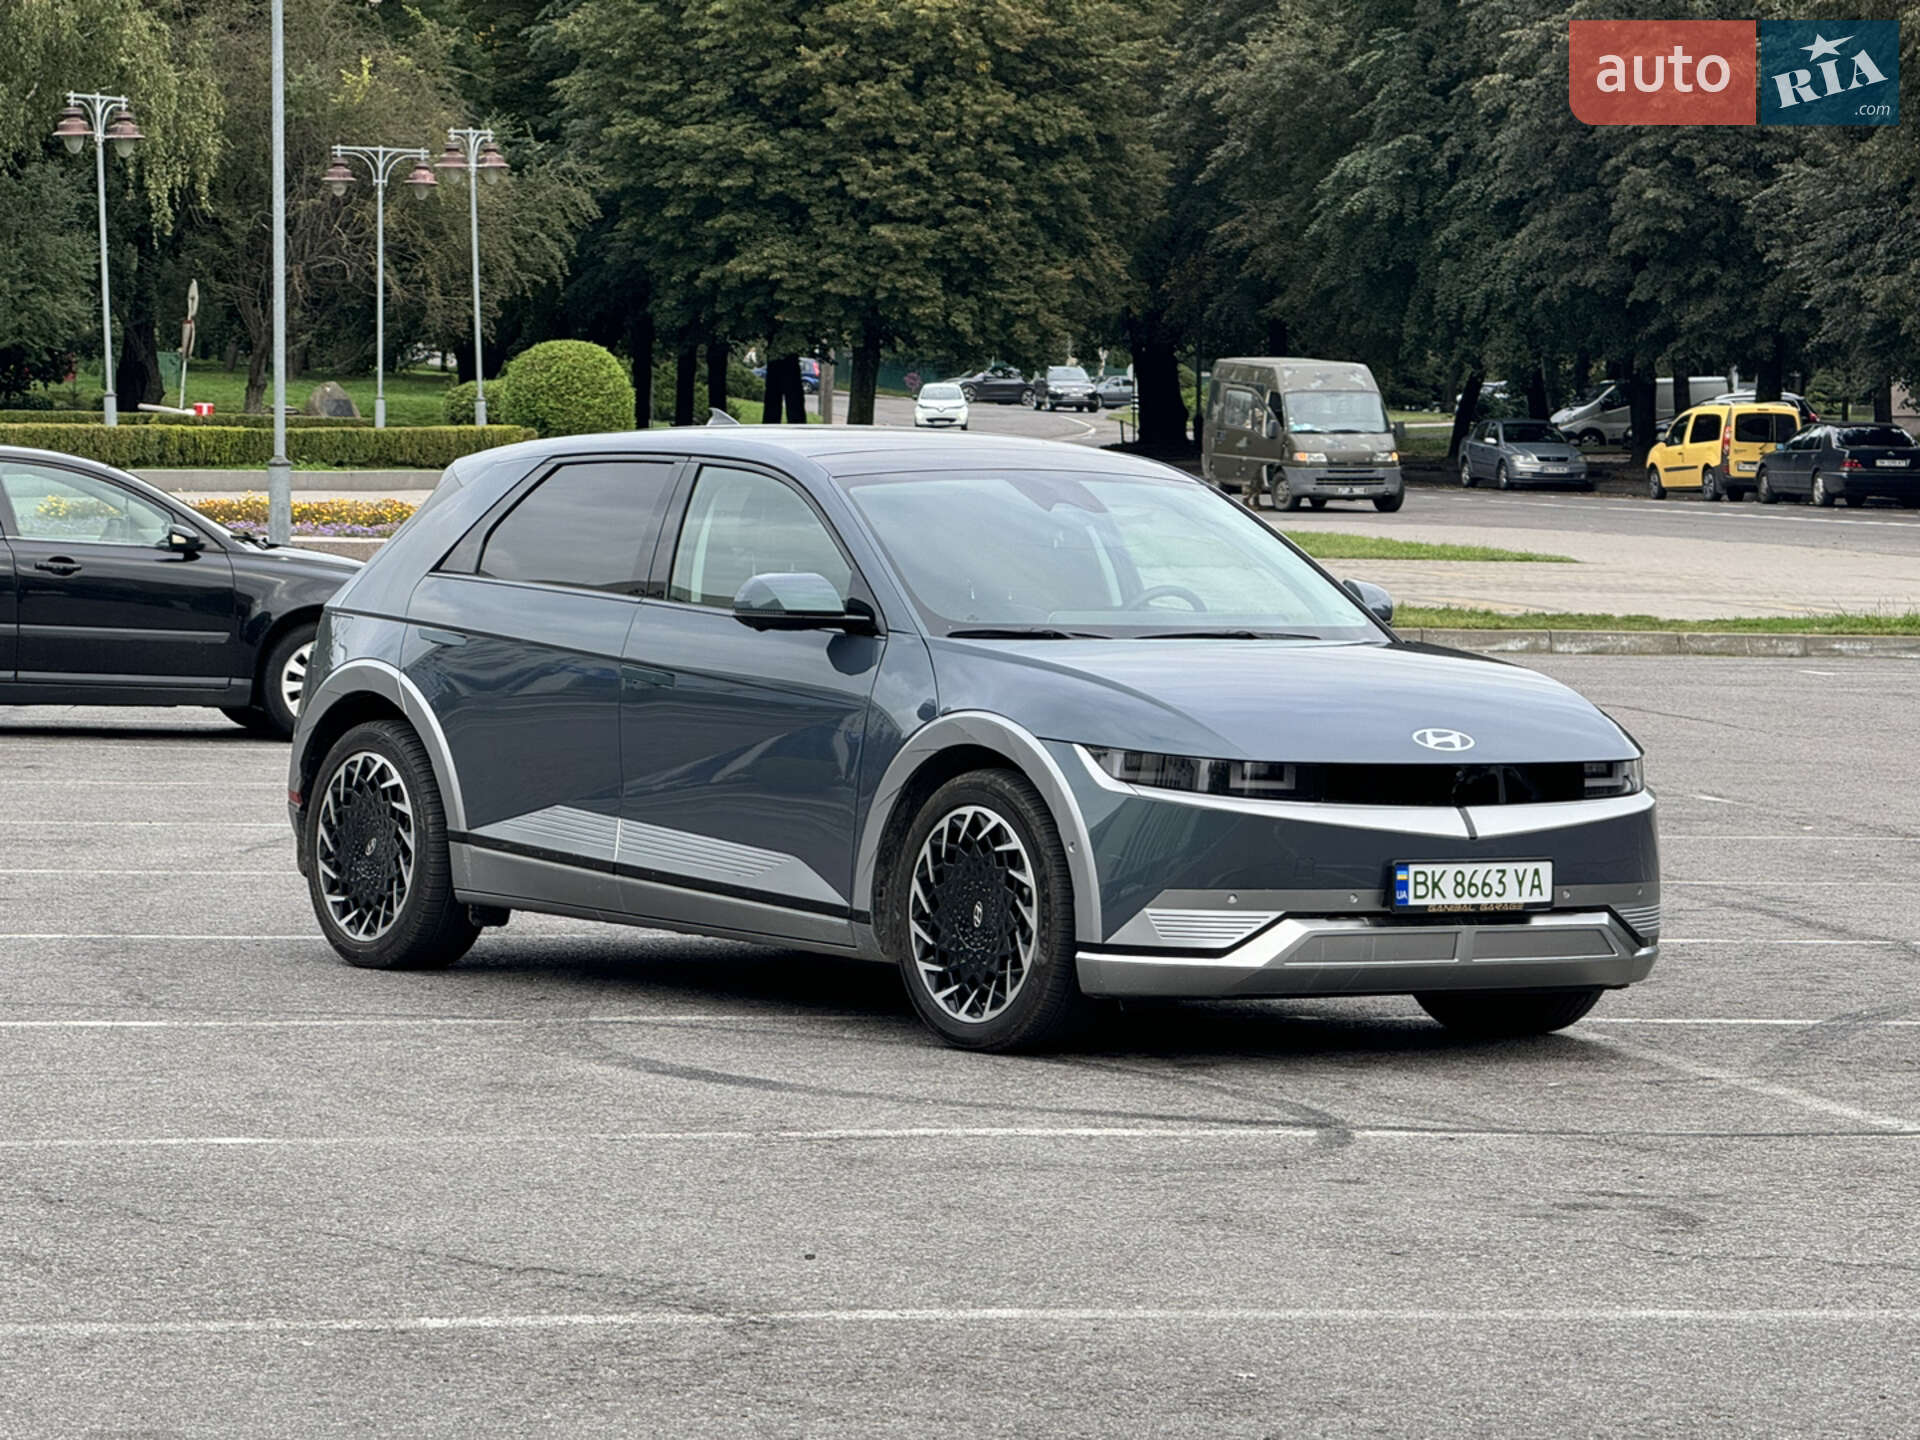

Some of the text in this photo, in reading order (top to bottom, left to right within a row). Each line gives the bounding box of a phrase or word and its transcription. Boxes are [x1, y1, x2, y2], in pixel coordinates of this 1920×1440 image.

[1413, 868, 1544, 899] BK 8663 YA
[1396, 889, 1408, 900] UA
